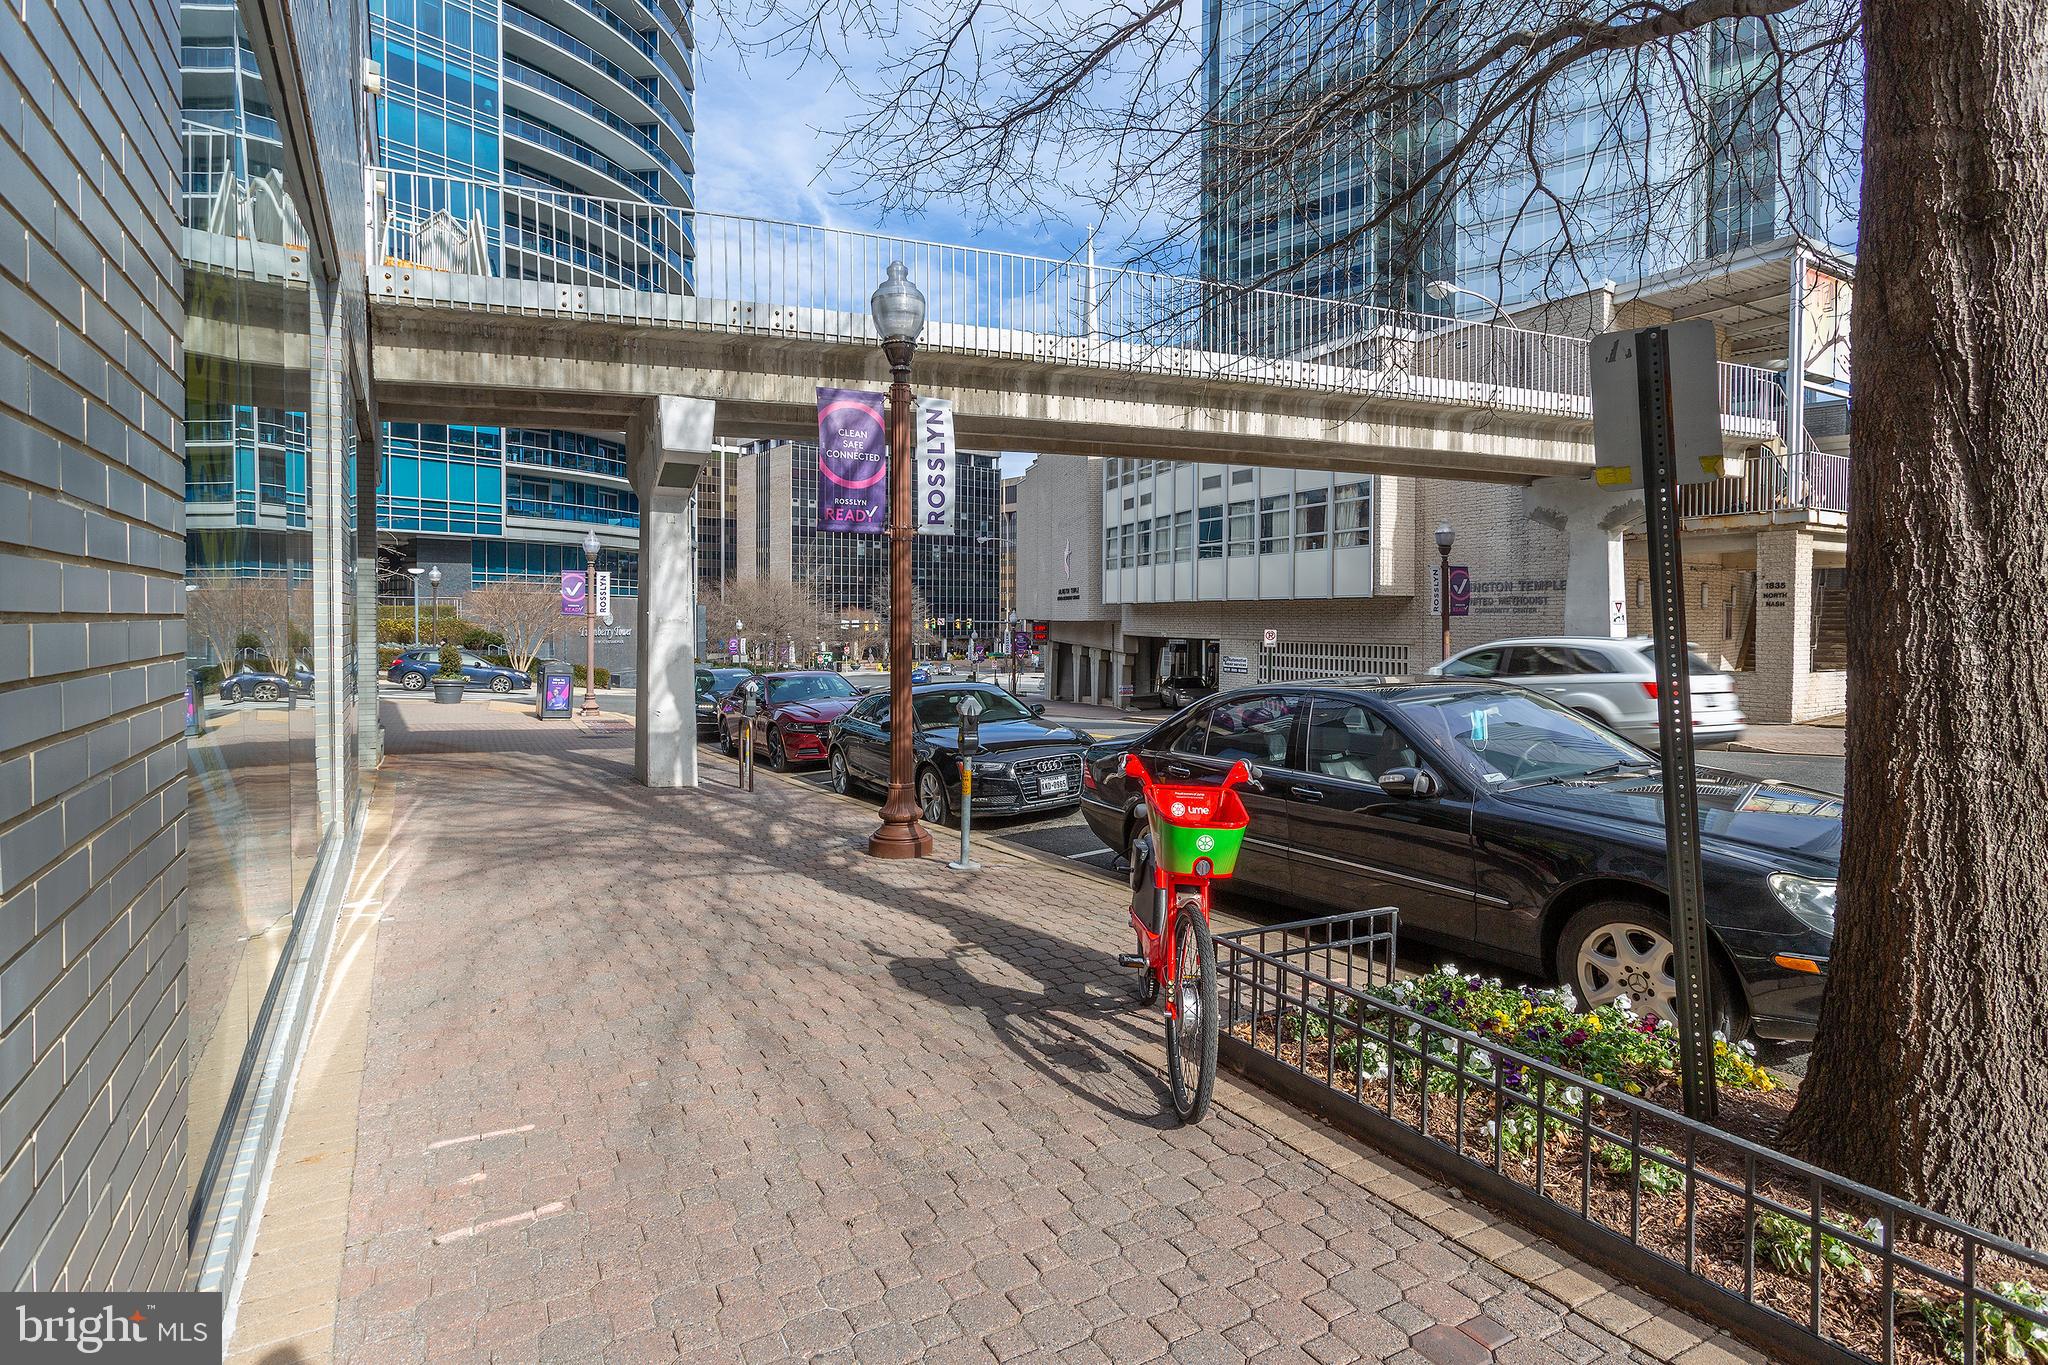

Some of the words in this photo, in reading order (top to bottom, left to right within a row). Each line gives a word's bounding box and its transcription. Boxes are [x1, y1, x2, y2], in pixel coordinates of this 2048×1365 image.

[838, 428, 868, 439] CLEAN
[843, 440, 864, 450] SAFE
[826, 450, 880, 462] CONNECTED
[926, 409, 945, 525] ROSSLYN
[834, 498, 867, 506] ROSSLYN
[825, 505, 878, 523] READY
[1519, 579, 1567, 591] TEMPLE
[1499, 596, 1549, 606] METHODIST
